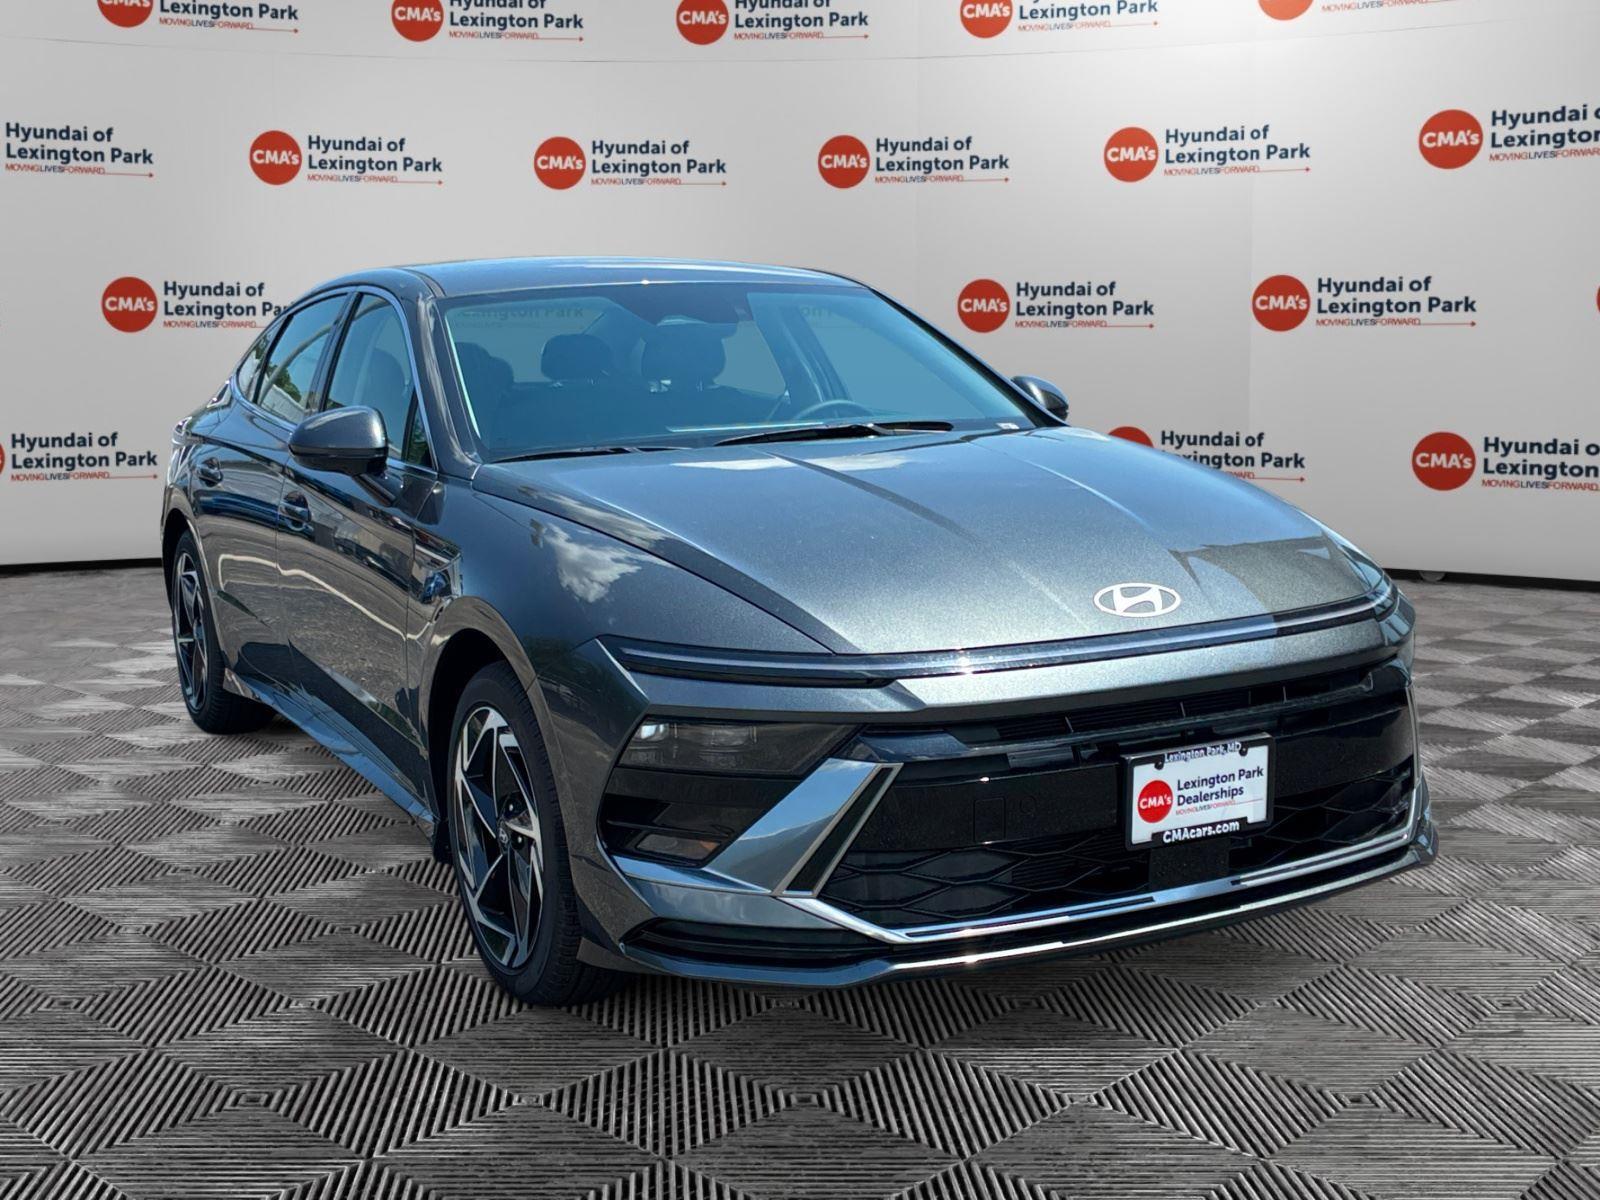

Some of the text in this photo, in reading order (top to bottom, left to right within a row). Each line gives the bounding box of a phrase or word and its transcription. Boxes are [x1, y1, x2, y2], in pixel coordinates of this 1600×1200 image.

[159, 0, 298, 20] Lexington Park
[394, 6, 441, 22] CMA's
[679, 10, 727, 25] CMA's
[962, 4, 1010, 19] CMA's
[1019, 0, 1158, 20] Lexington Park
[450, 11, 584, 30] Lexington Park
[735, 11, 868, 31] Lexington Park
[1491, 104, 1588, 130] Hyundai
[6, 122, 114, 142] Hyundai of
[1166, 124, 1270, 147] Hyundai of
[1422, 130, 1480, 148] CMA's
[6, 142, 154, 165] Lexington Park
[308, 135, 406, 154] Hyundai of
[591, 140, 690, 158] Hyundai of
[876, 136, 973, 156] Hyundai of
[1165, 143, 1310, 165] Lexington Park
[253, 150, 299, 166] CMA's
[308, 154, 442, 174] Lexington Park
[537, 155, 583, 170] CMA's
[821, 154, 868, 169] CMA's
[876, 154, 1009, 174] Lexington Park
[1106, 147, 1156, 162] CMA's
[1489, 147, 1600, 162] MOVINGLIVESFORWAR
[591, 159, 726, 177] Lexington Park
[164, 281, 265, 299] Hyundai of
[1016, 281, 1116, 300] Hyundai of
[1317, 275, 1432, 296] Hyundai of
[105, 297, 154, 312] CMA's
[164, 301, 295, 320] Lexington Pa
[960, 298, 1007, 313] CMA's
[1016, 300, 1154, 319] Lexington Park
[1255, 294, 1307, 311] CMA's
[1317, 296, 1476, 317] Lexington Park
[11, 432, 118, 452] Hyundai of
[1161, 430, 1265, 449] Hyundai of
[1484, 436, 1600, 457] Hyundai o
[11, 451, 157, 471] Lexington Park
[1260, 452, 1305, 468] Park
[1415, 452, 1473, 469] CMA's
[1483, 458, 1599, 480] Lexington
[1177, 766, 1264, 791] Lexington Park
[1138, 794, 1172, 811] CMA's
[1177, 785, 1244, 806] Dealerships
[1163, 821, 1240, 843] CMAcars.com
